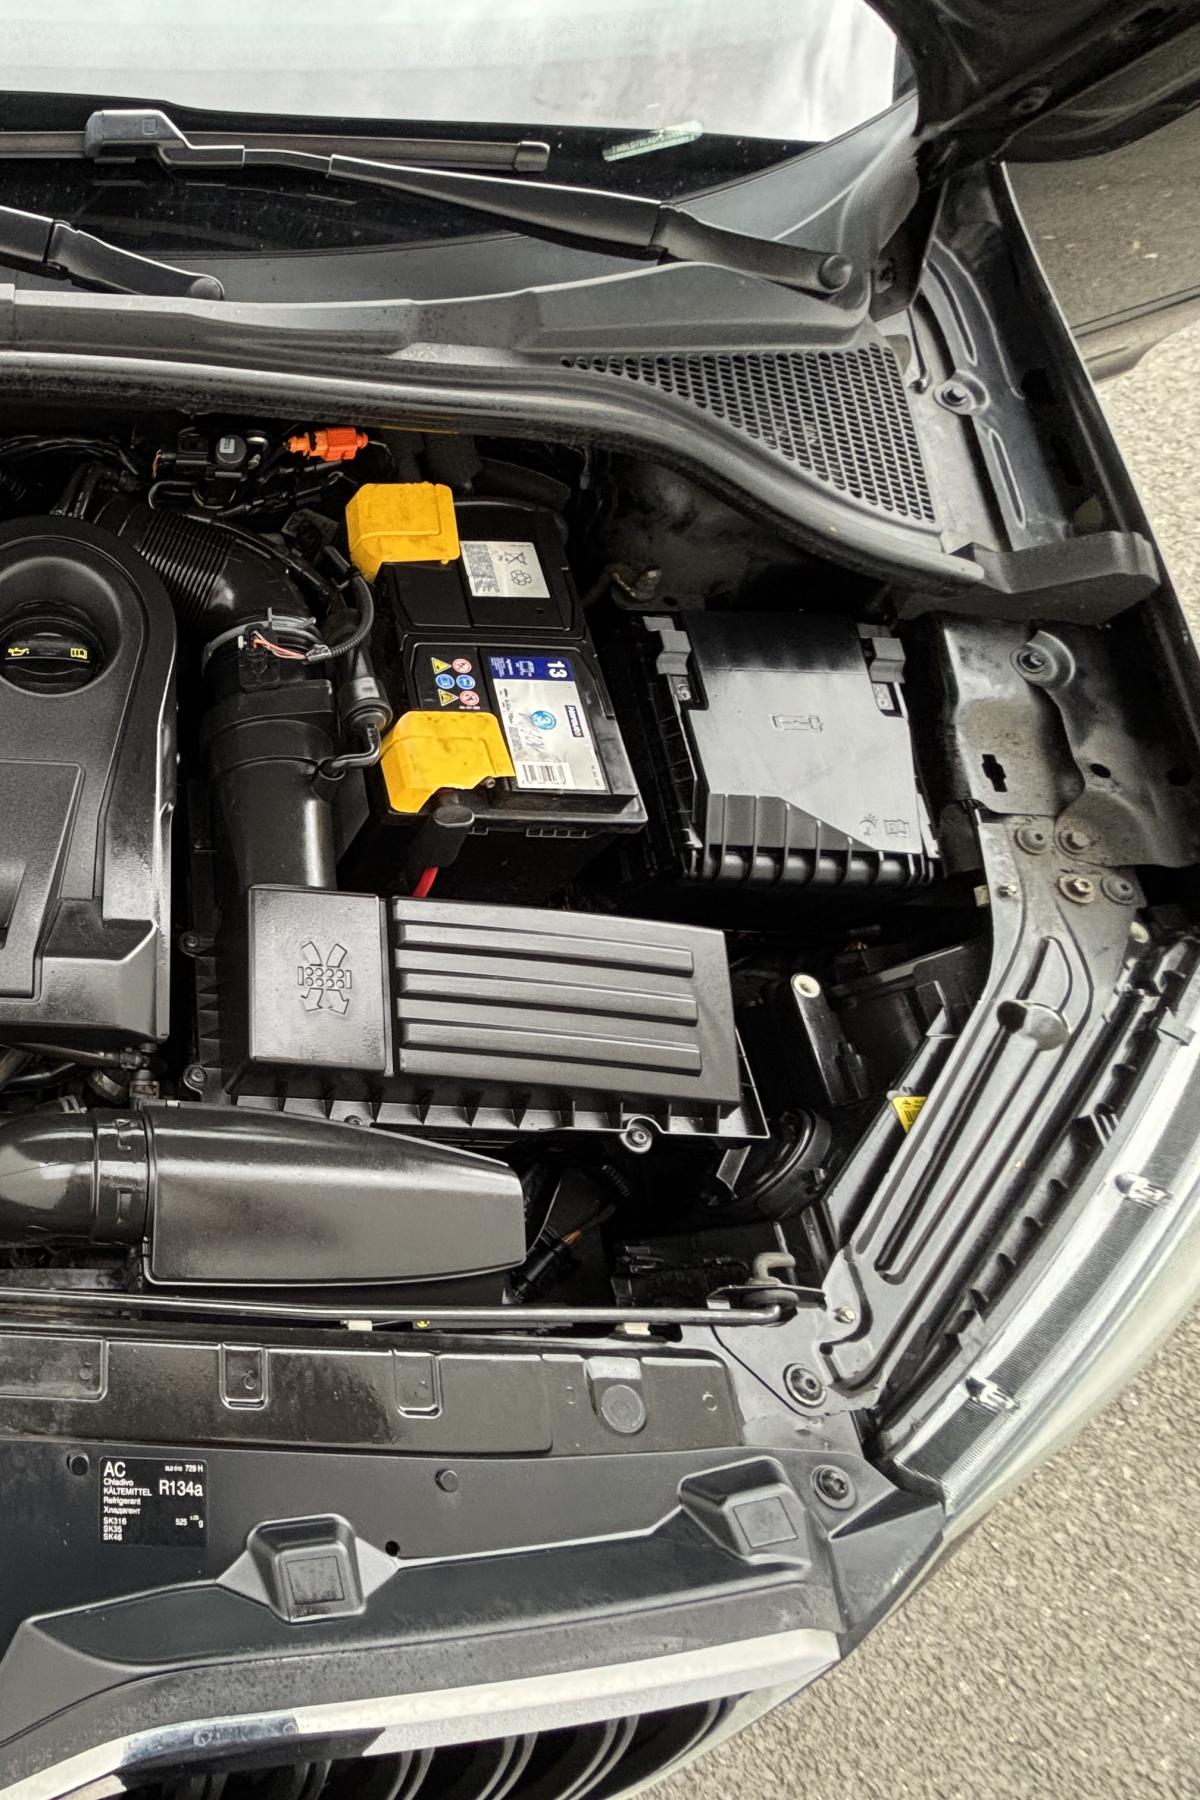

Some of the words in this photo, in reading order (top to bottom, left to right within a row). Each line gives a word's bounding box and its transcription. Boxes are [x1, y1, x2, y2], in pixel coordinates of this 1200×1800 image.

[547, 660, 568, 678] 13
[103, 1461, 126, 1477] AC
[197, 1464, 204, 1472] H
[103, 1478, 134, 1486] Chladivo
[103, 1487, 152, 1496] KÄLTEMITTEL
[159, 1479, 204, 1497] R134a
[103, 1496, 141, 1506] Refrigerant
[103, 1506, 141, 1515] Хладагент
[103, 1517, 127, 1525] SK316
[175, 1517, 188, 1526] 525
[103, 1525, 123, 1533] SK35
